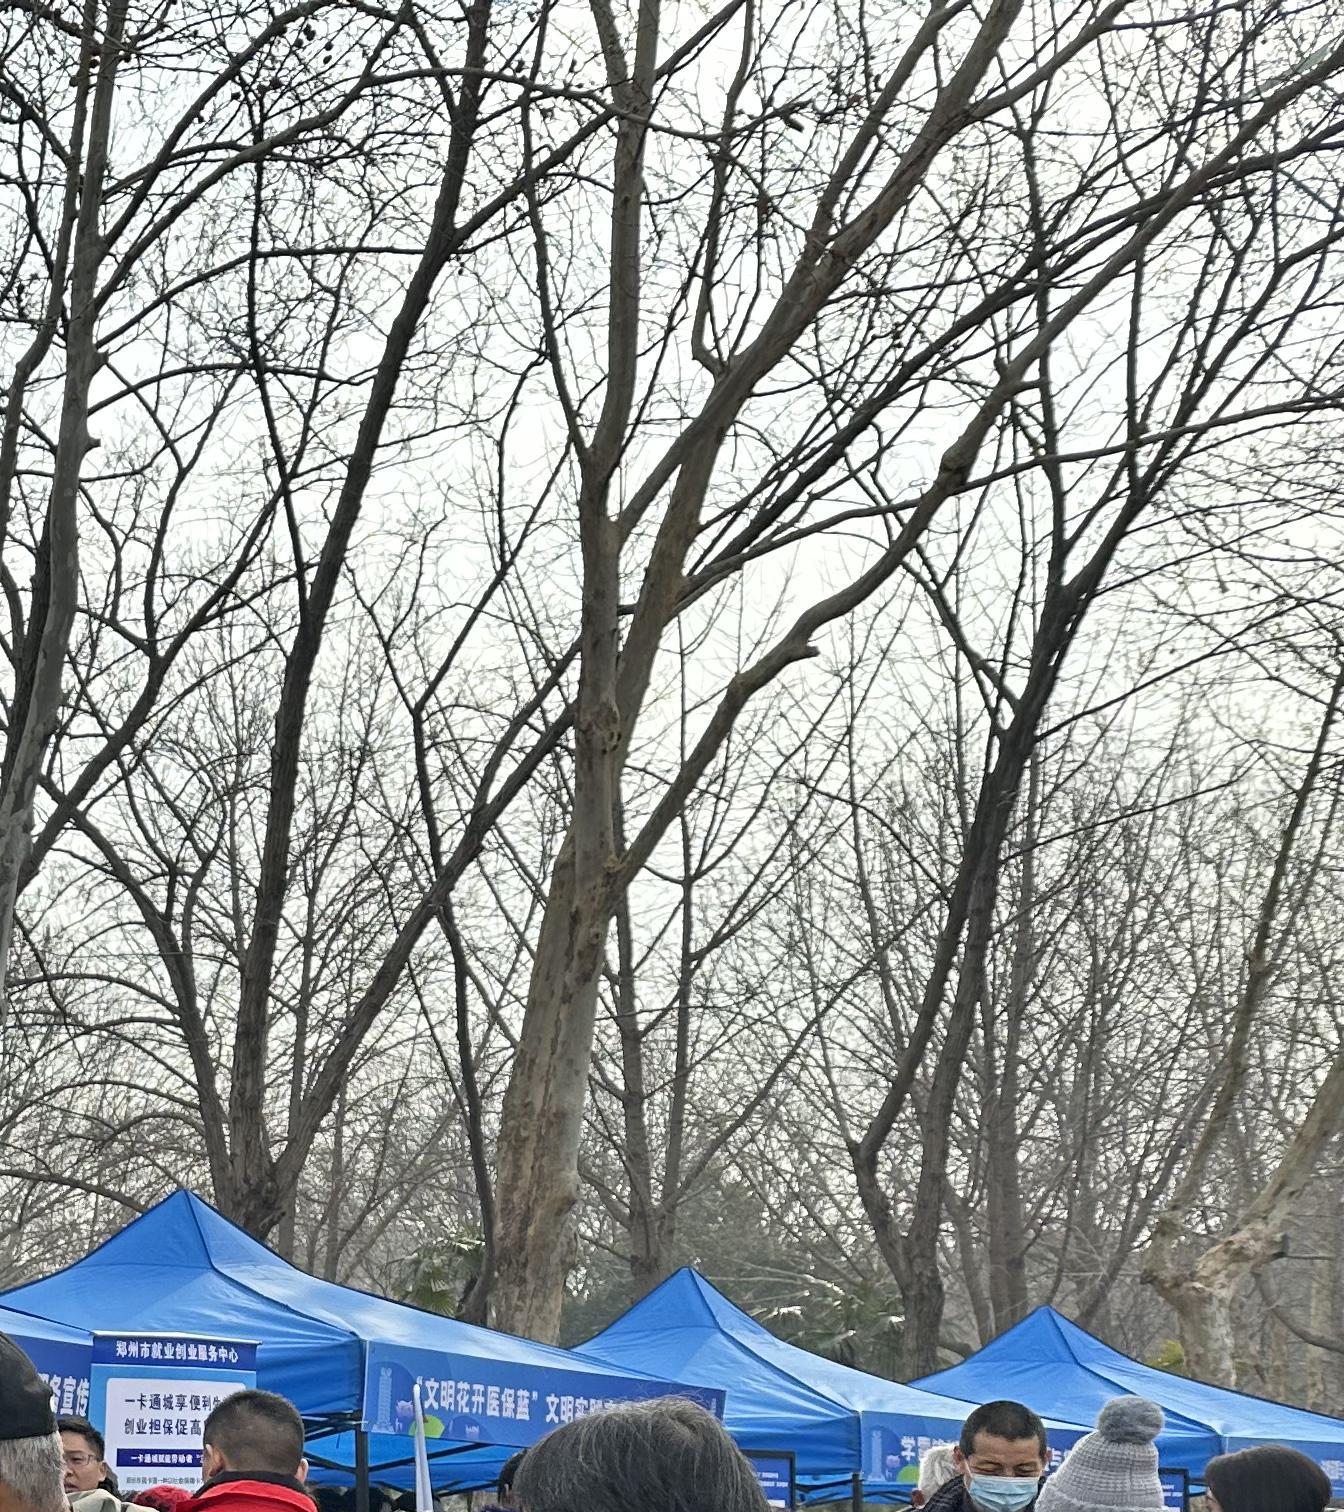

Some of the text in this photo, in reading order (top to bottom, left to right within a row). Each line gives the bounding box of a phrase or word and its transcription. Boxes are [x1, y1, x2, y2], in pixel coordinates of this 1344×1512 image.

[116, 1340, 239, 1364] 郑州市就业创业服务中心
[38, 1373, 90, 1417] 务宣传
